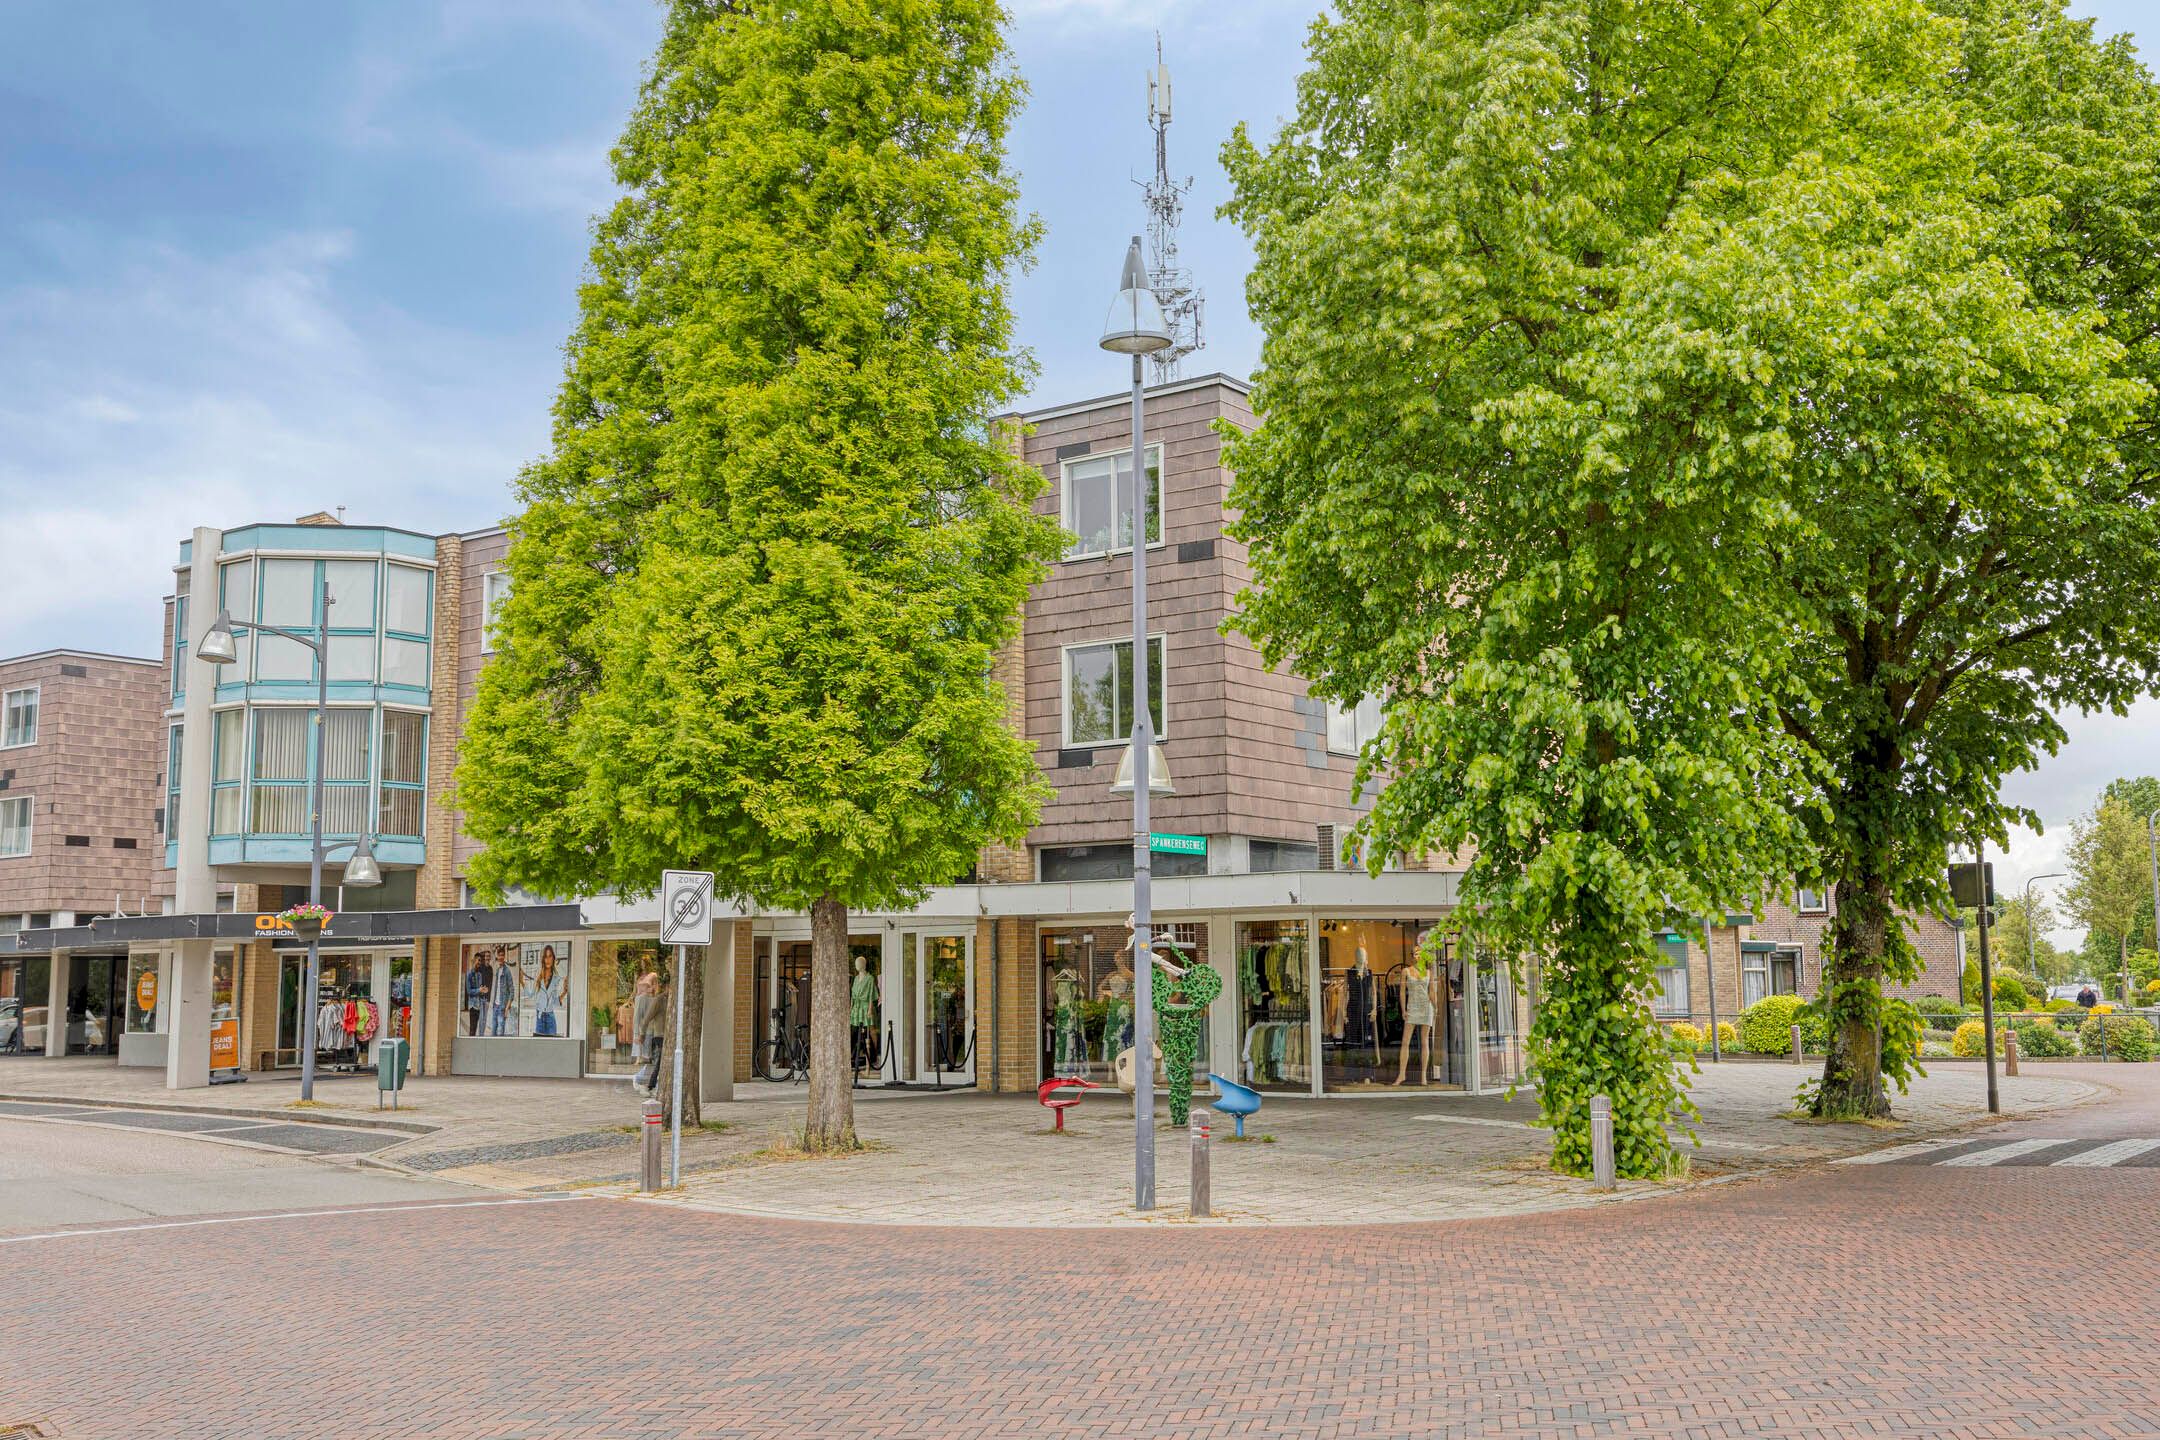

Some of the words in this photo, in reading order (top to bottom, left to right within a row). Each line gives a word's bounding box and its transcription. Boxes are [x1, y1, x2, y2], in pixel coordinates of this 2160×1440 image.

[1151, 837, 1205, 851] SPANKERENSEWEG
[678, 876, 701, 884] ZONE
[255, 915, 334, 930] OKY
